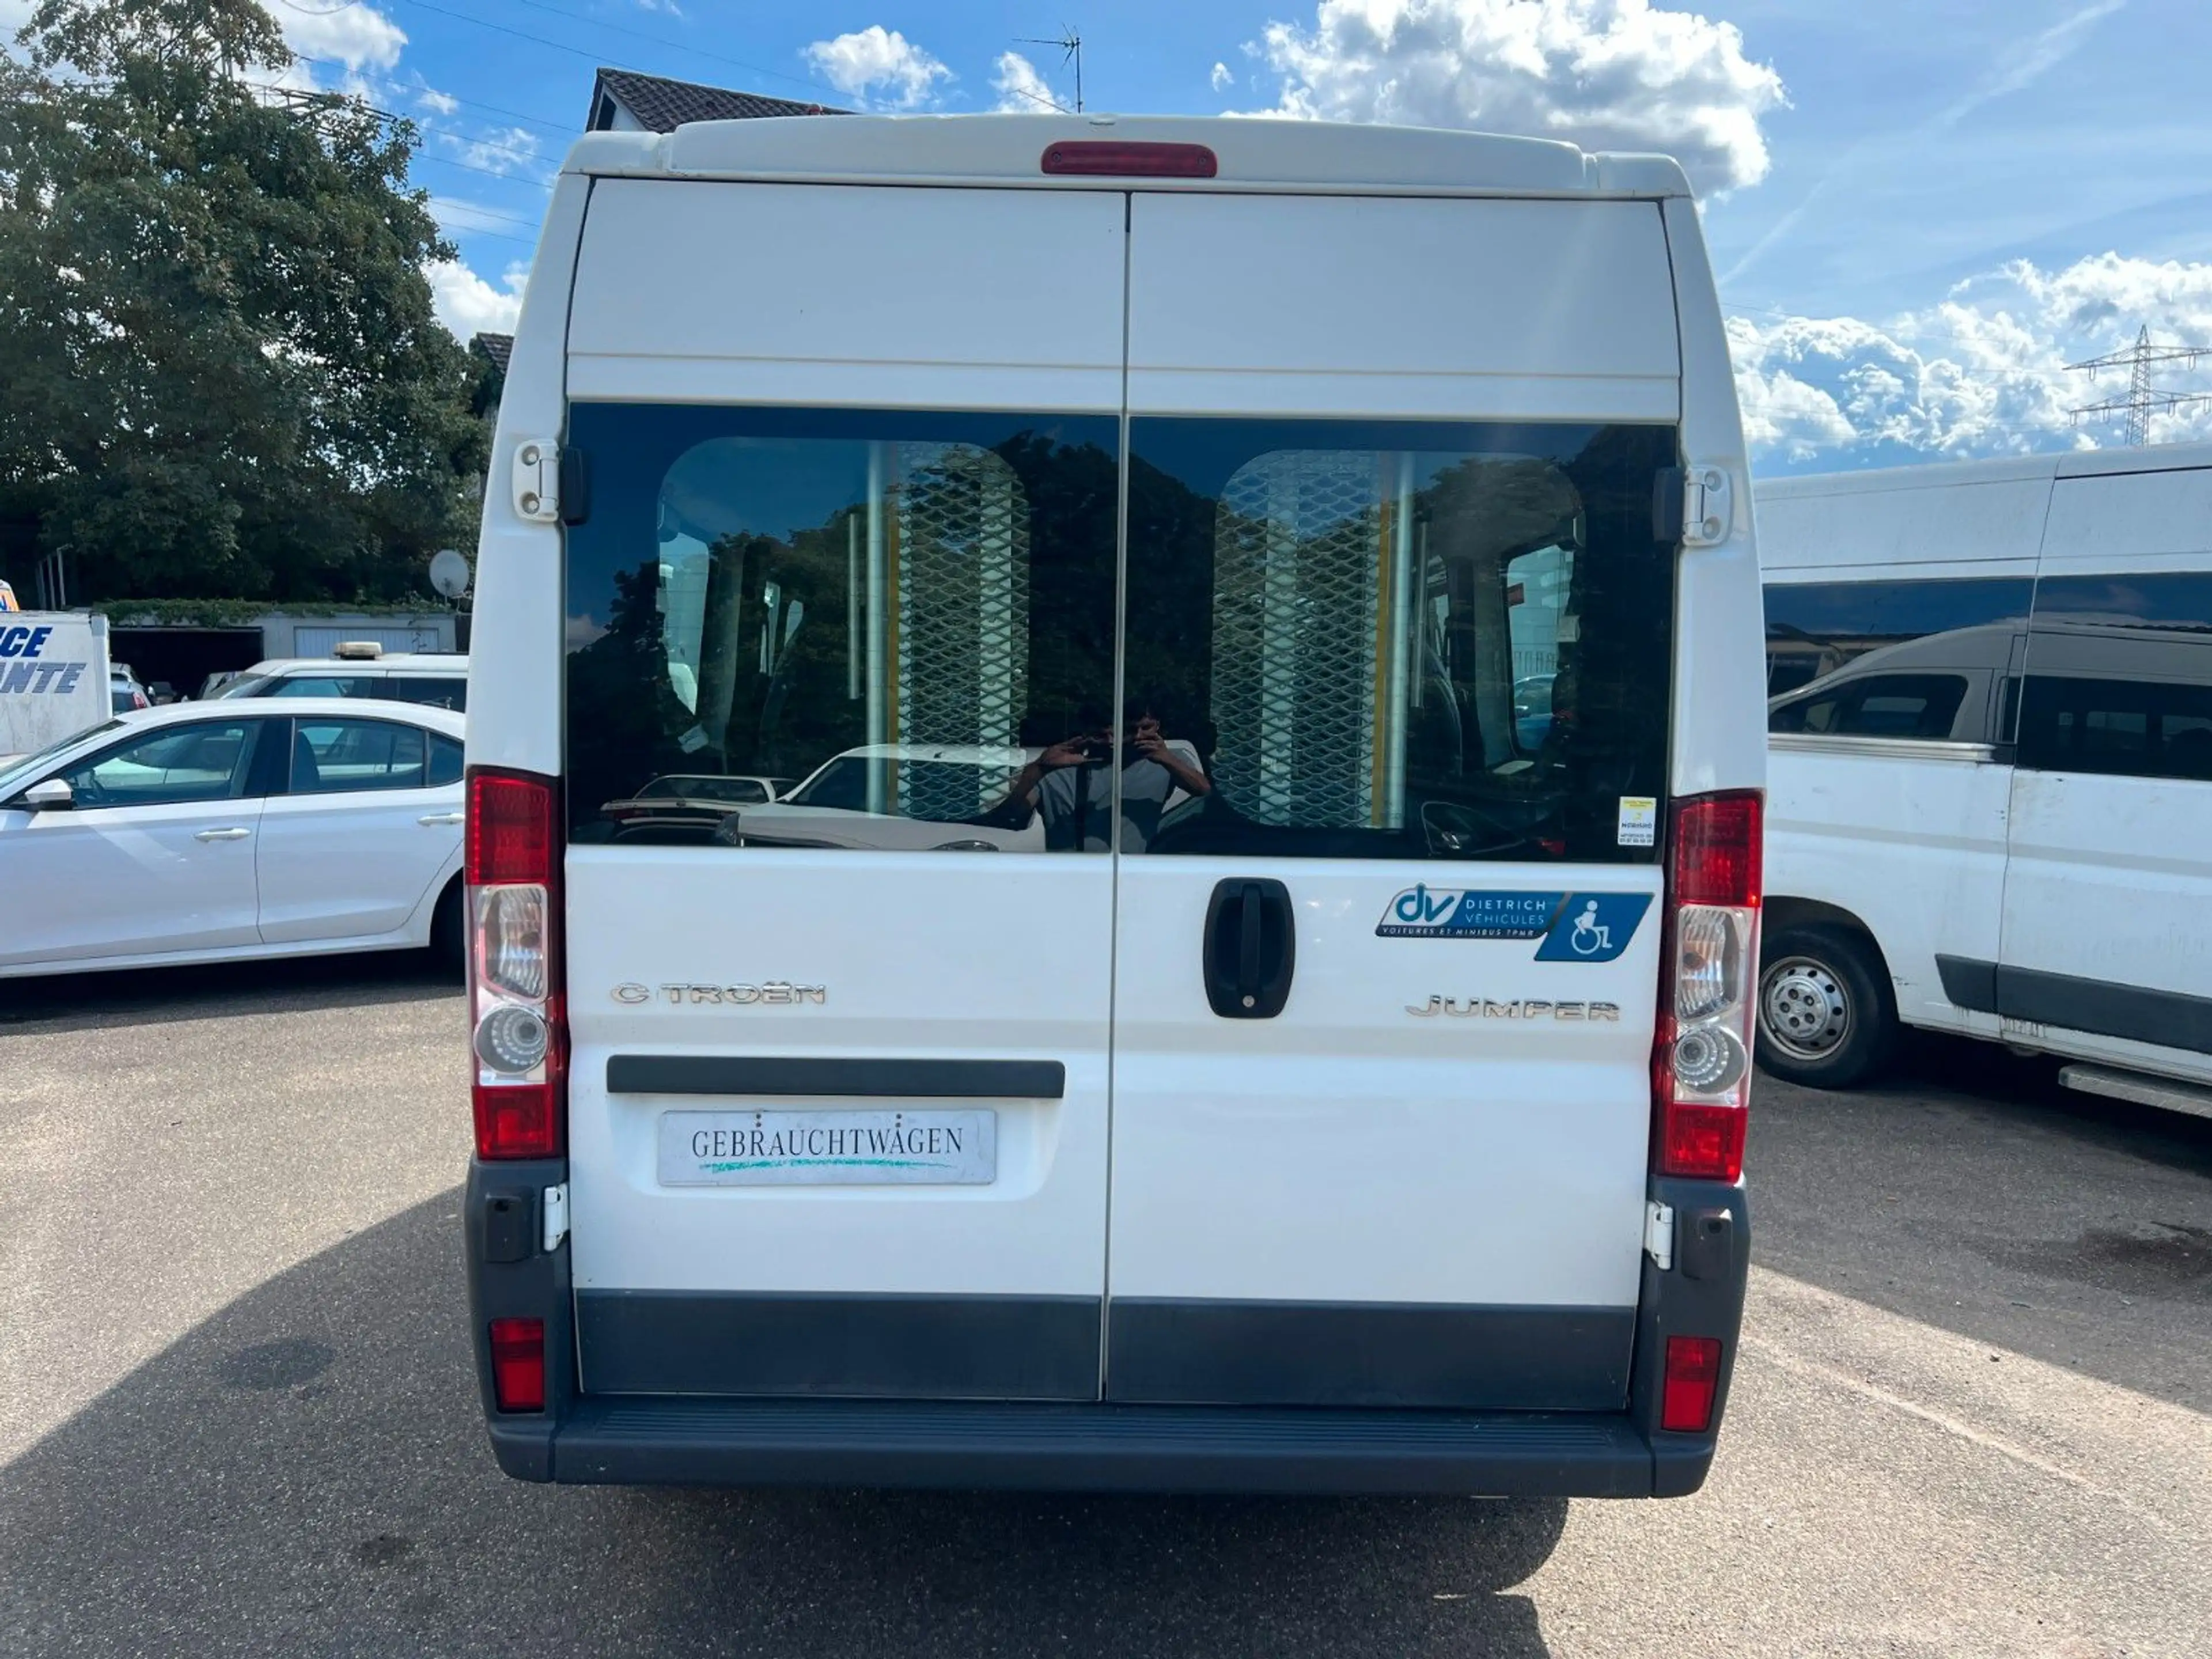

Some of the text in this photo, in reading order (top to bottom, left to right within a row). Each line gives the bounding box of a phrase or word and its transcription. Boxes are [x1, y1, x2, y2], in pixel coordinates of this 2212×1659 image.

[1465, 899, 1546, 911] DIETRICH
[1455, 928, 1501, 936] MINIBUS
[1404, 995, 1620, 1021] JUMPER
[692, 1127, 964, 1158] GEBRAUCHTWAGEN
